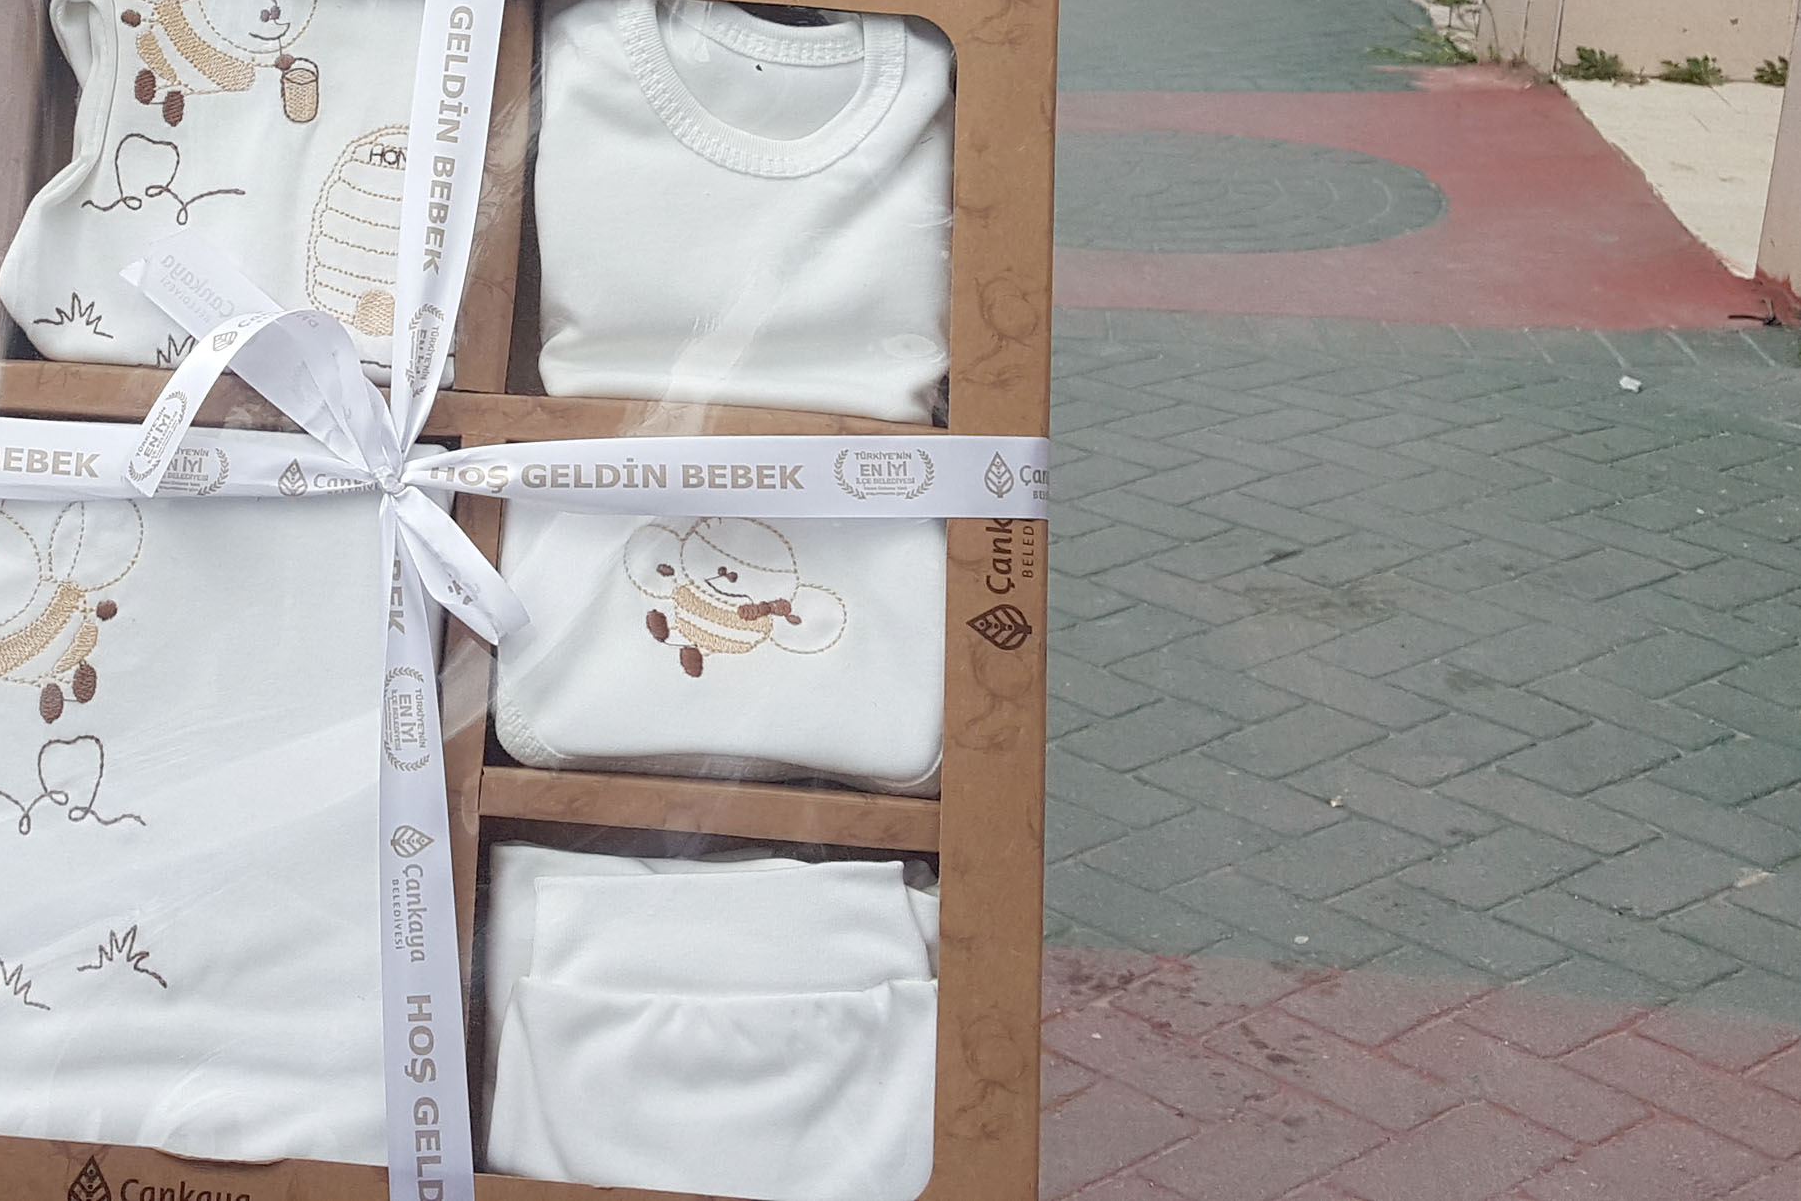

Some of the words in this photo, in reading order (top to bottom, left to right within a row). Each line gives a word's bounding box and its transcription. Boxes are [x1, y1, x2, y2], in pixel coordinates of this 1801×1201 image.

[433, 5, 475, 145] GELDİN
[422, 155, 456, 277] BEBEK
[520, 452, 670, 490] GELDİN
[681, 463, 806, 492] BEBEK
[860, 463, 882, 477] EN
[887, 461, 907, 477] İYİ
[986, 519, 1015, 595] Çank
[399, 695, 412, 717] EN
[392, 879, 405, 949] BELEDİYESİ
[402, 863, 427, 962] Çankaya
[404, 995, 436, 1083] HOŞ
[413, 1097, 444, 1201] GELD
